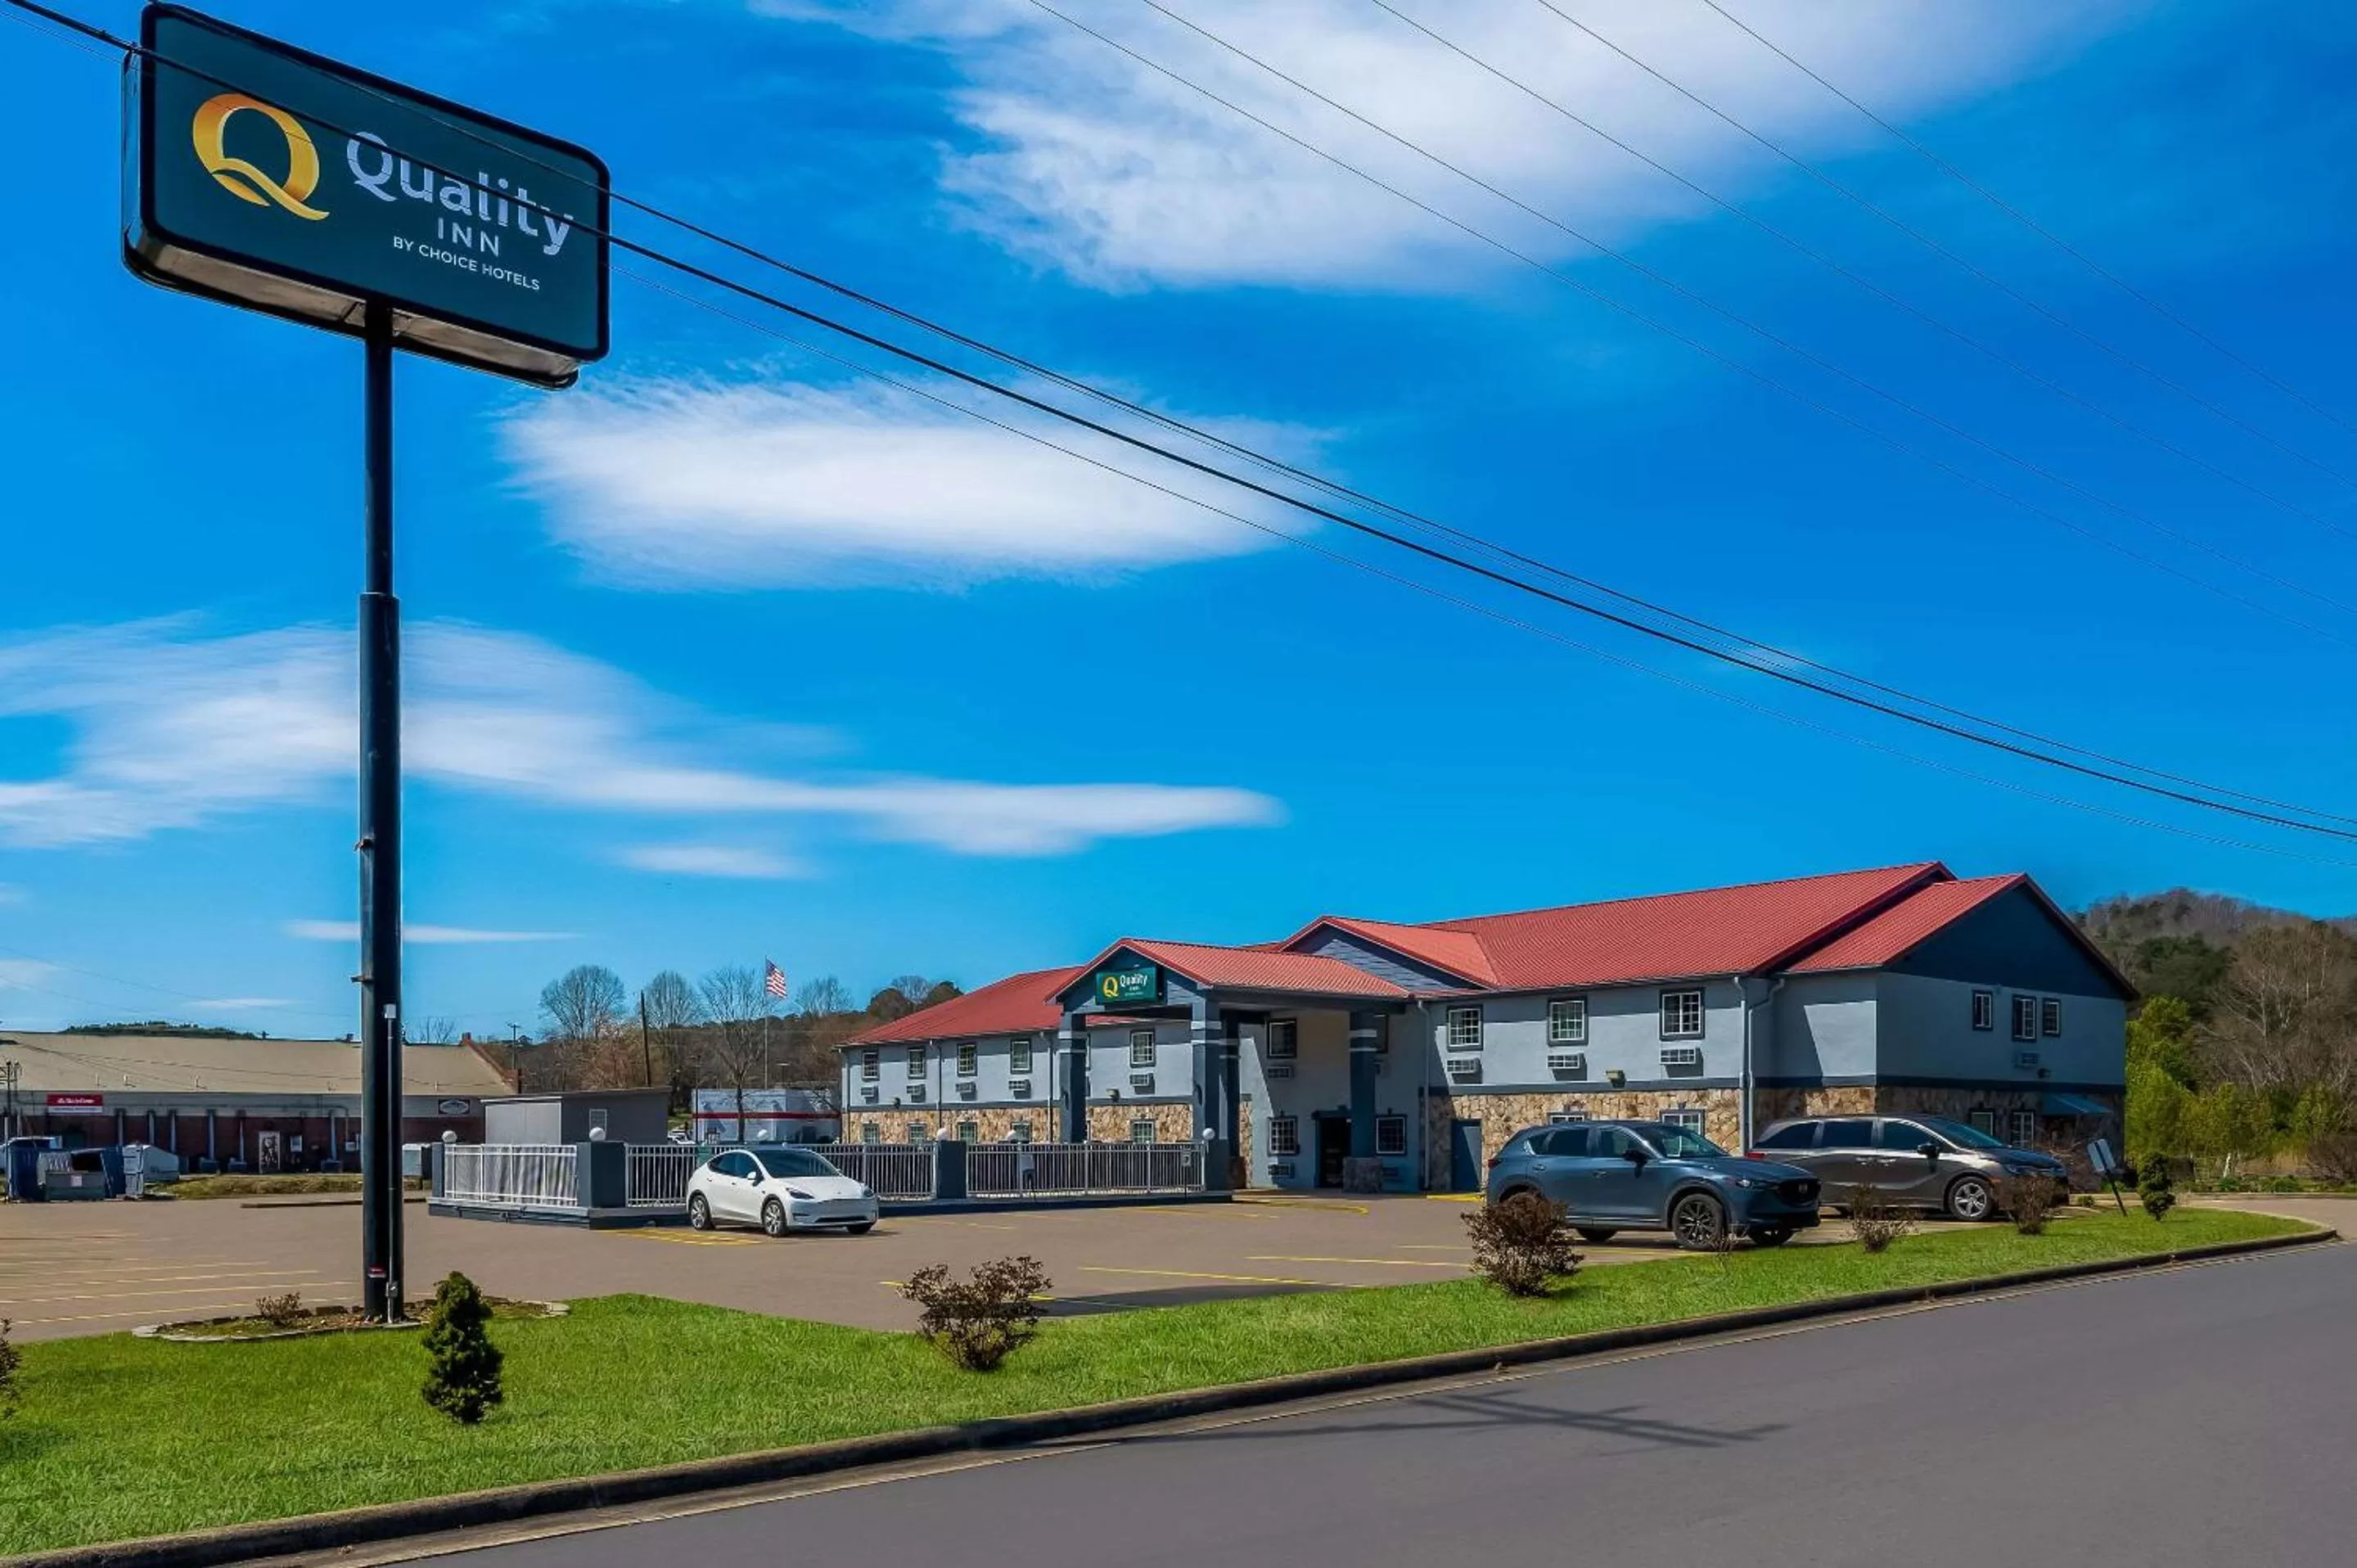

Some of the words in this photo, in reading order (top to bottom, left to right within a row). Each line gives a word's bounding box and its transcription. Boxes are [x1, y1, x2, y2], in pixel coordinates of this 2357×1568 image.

[192, 93, 330, 220] Q
[347, 132, 574, 255] Quality
[393, 236, 414, 251] BY
[418, 245, 478, 272] CHOICE
[482, 264, 540, 291] HOTELS
[438, 217, 499, 257] INN
